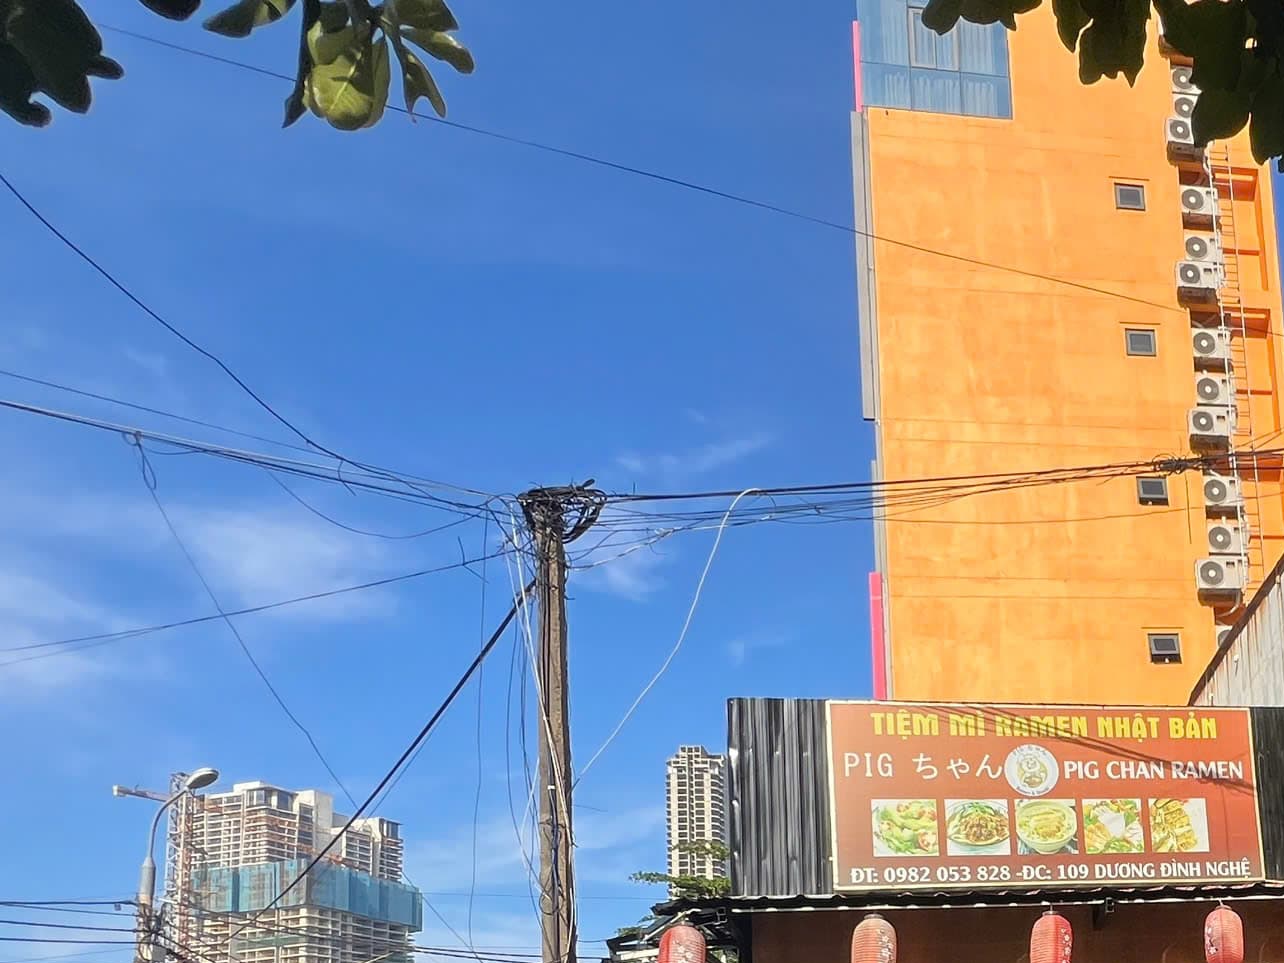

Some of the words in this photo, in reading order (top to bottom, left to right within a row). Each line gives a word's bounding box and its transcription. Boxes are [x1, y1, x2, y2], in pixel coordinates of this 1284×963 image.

[870, 709, 939, 740] TIỆM
[949, 710, 985, 737] MÌ
[994, 714, 1088, 739] RAMEN
[1097, 712, 1160, 743] NHẬT
[1169, 711, 1217, 739] BẢN
[844, 752, 893, 777] PIG
[912, 753, 1003, 780] ちゃん
[1064, 760, 1099, 779] PIG
[1106, 760, 1165, 779] CHAN
[1171, 760, 1243, 780] RAMEN
[850, 868, 878, 883] ĐT:
[884, 867, 930, 882] 0982
[936, 866, 971, 882] 053
[976, 866, 1011, 881] 828
[1056, 864, 1089, 879] 109
[1094, 862, 1155, 879] DƯƠNG
[1160, 860, 1200, 877] ĐÌNH
[1206, 857, 1250, 879] NGHỆ
